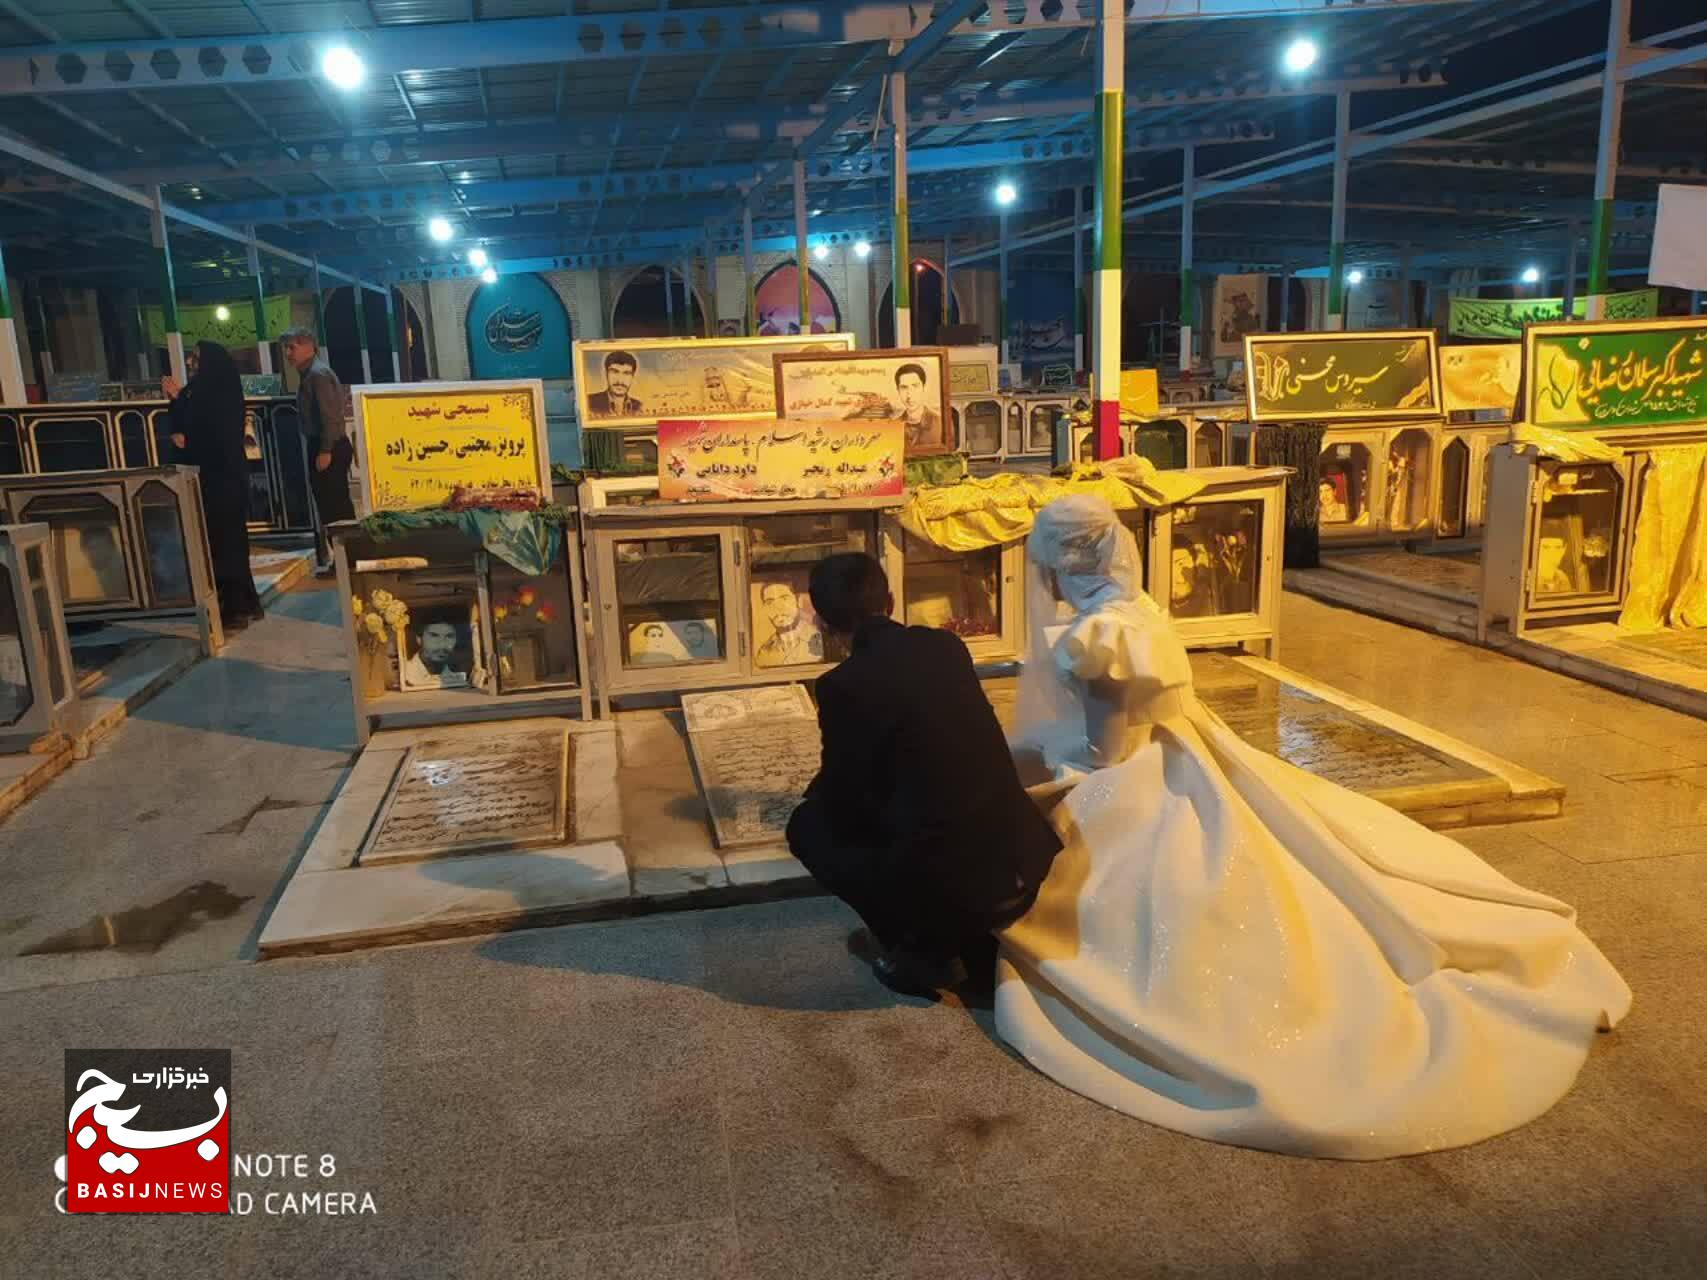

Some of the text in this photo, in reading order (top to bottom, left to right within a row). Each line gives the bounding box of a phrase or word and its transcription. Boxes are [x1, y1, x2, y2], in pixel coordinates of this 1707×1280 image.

[1286, 354, 1389, 395] سیروس محسنی
[1671, 350, 1702, 397] شهید
[407, 401, 489, 422] بسیجی شهید
[385, 436, 413, 462] زاده
[417, 438, 450, 461] حسین
[752, 430, 807, 462] اسلام
[733, 462, 758, 478] داود
